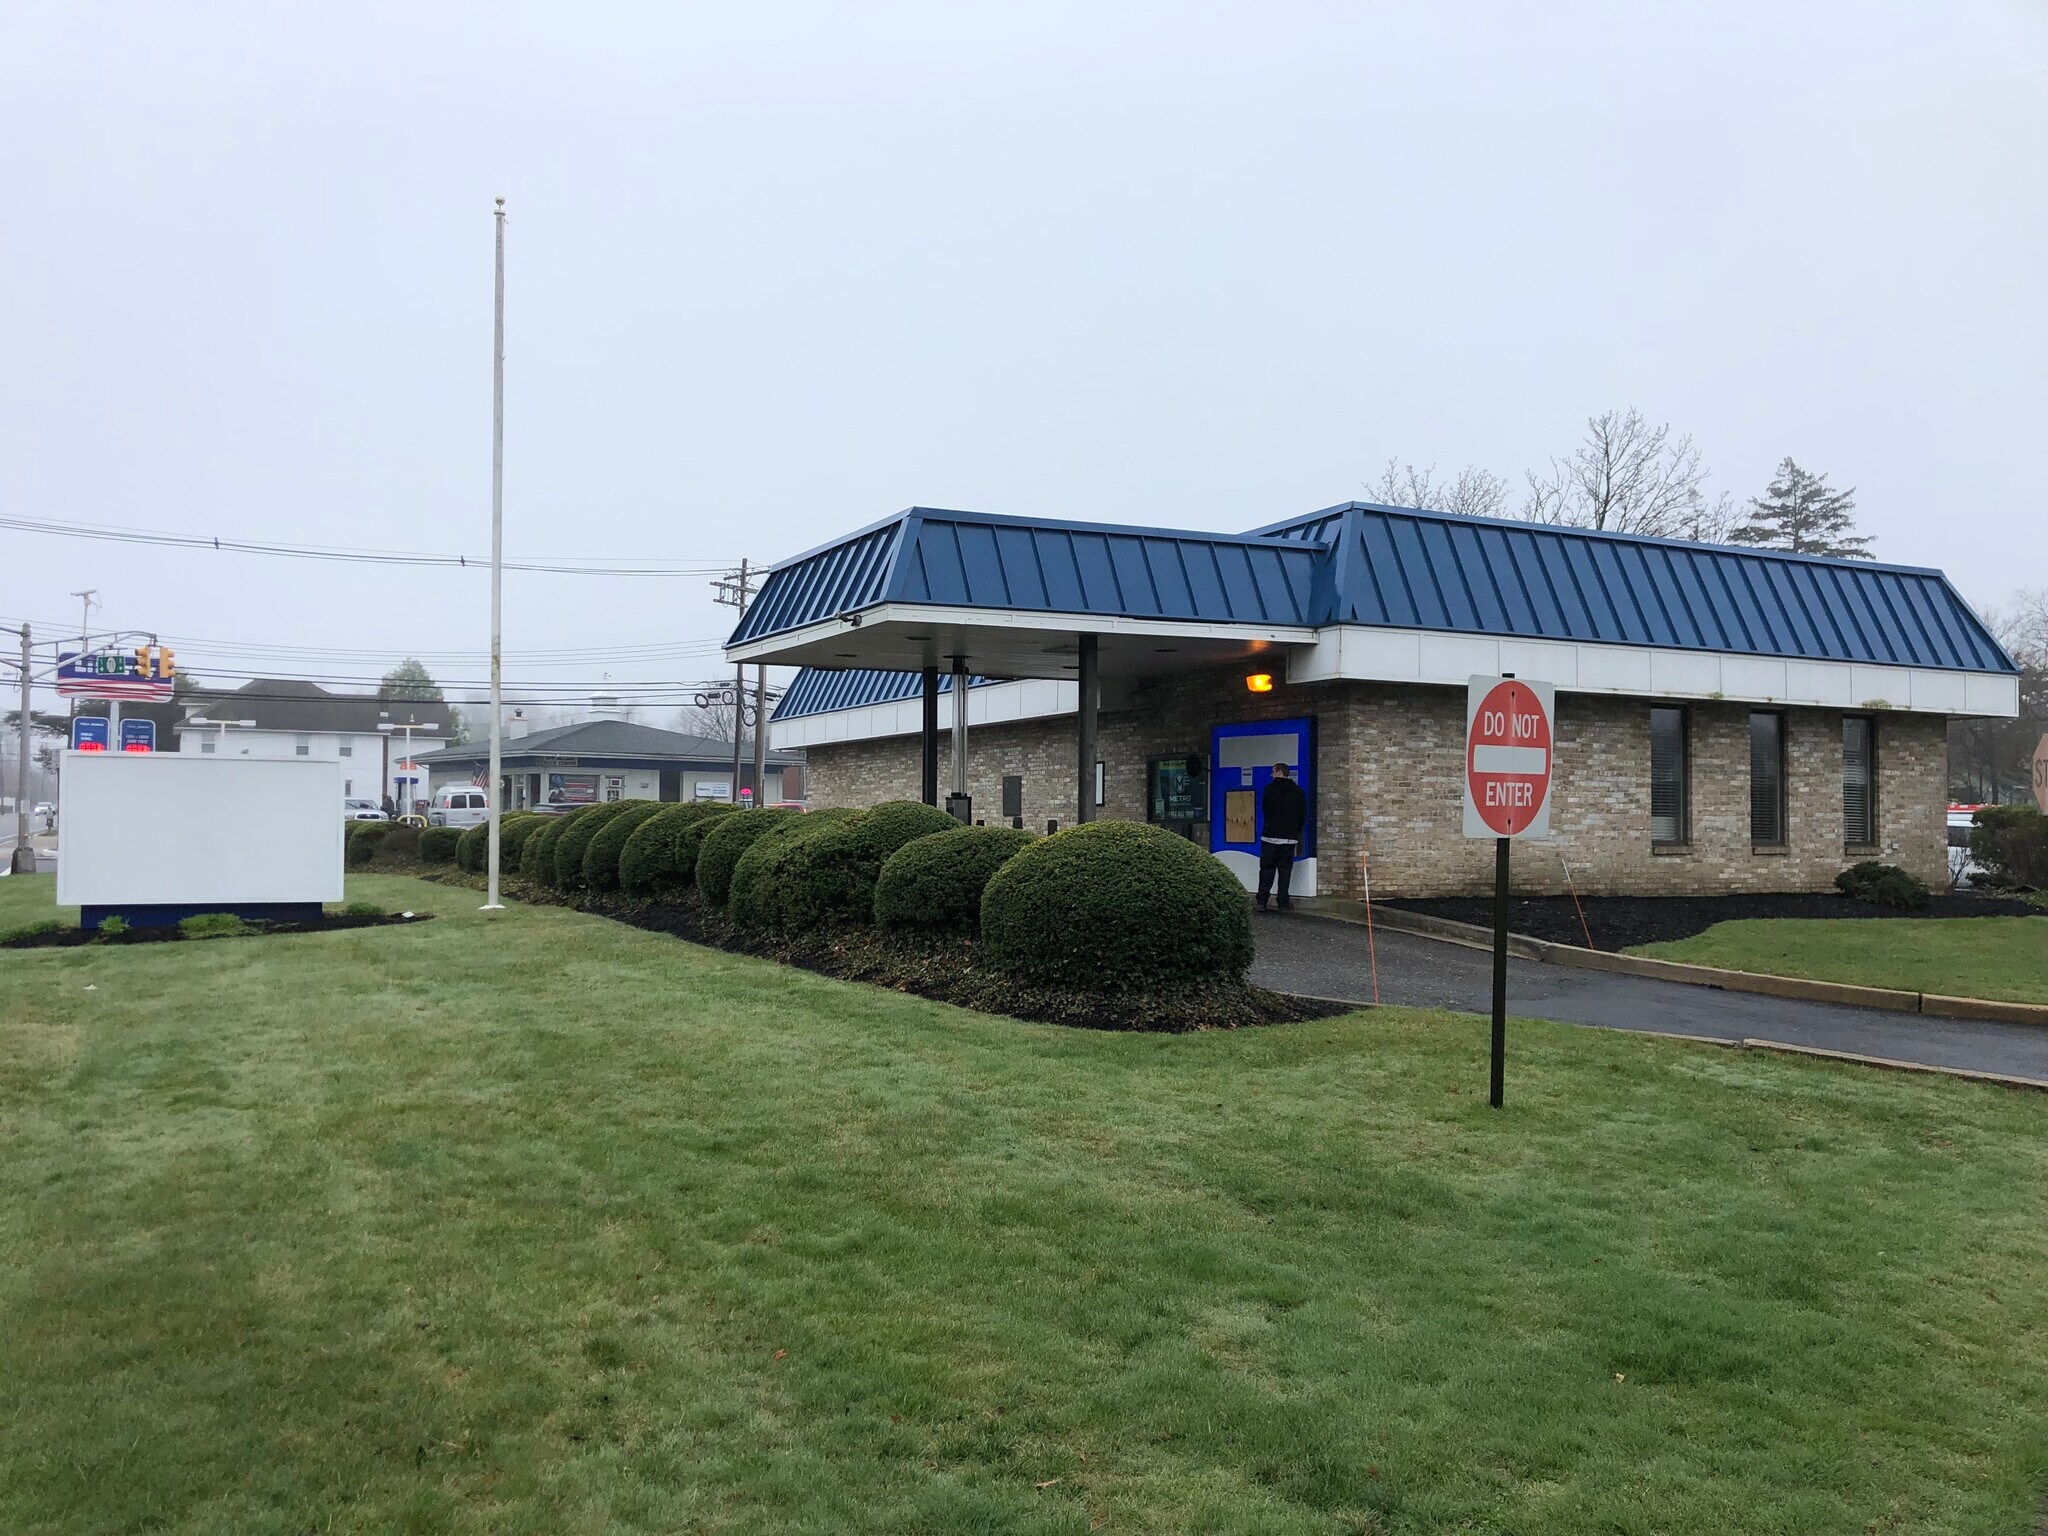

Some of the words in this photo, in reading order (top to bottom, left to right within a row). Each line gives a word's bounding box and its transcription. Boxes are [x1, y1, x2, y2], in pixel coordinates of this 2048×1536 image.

[1484, 711, 1505, 737] DO
[1511, 713, 1540, 739] NOT
[1169, 795, 1192, 803] METRO
[1485, 781, 1533, 807] ENTER
